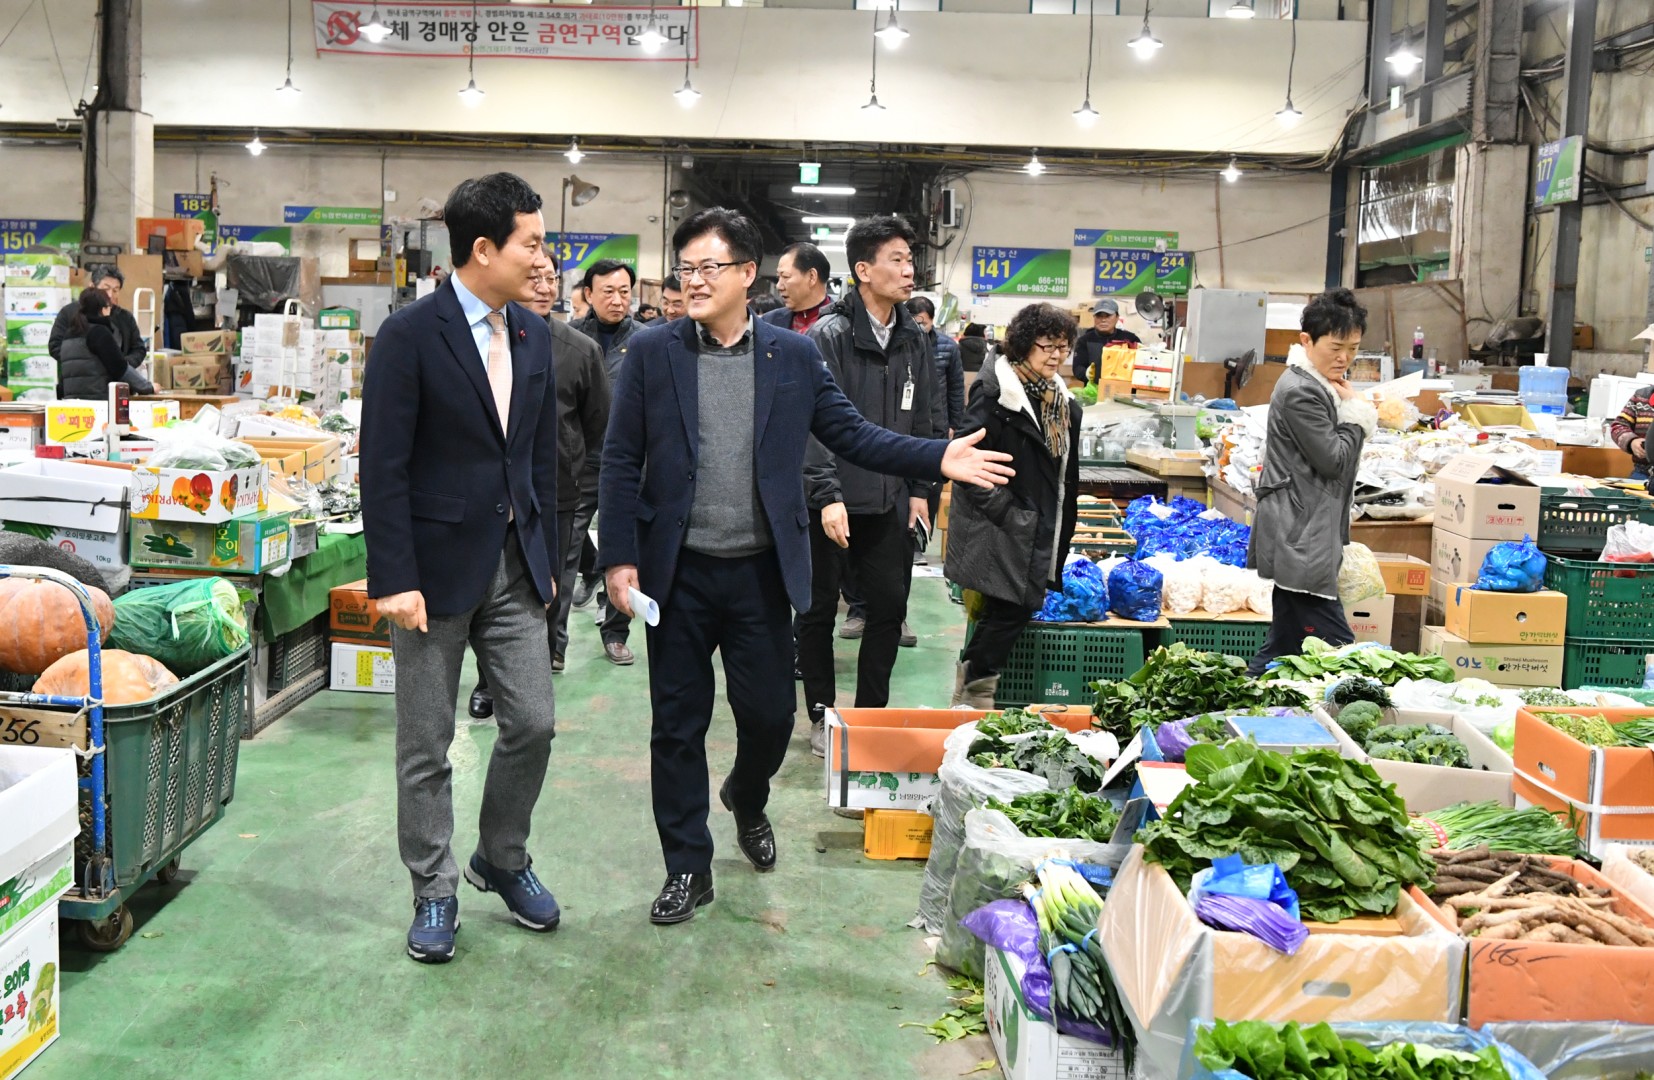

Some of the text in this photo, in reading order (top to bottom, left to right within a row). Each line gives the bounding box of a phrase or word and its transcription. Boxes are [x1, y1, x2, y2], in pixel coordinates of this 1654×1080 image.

[418, 21, 480, 42] 경매장
[487, 21, 529, 42] 안은
[1537, 158, 1553, 182] 177
[181, 199, 211, 211] 185
[2, 231, 36, 250] 150
[1099, 251, 1151, 261] 늘푸른상회
[1161, 257, 1186, 268] 244
[976, 259, 1010, 278] 141
[1099, 260, 1138, 281] 229
[141, 494, 184, 507] PAPRIKA
[216, 529, 239, 555] 오이
[95, 555, 112, 564] 10kg
[0, 717, 41, 744] 56
